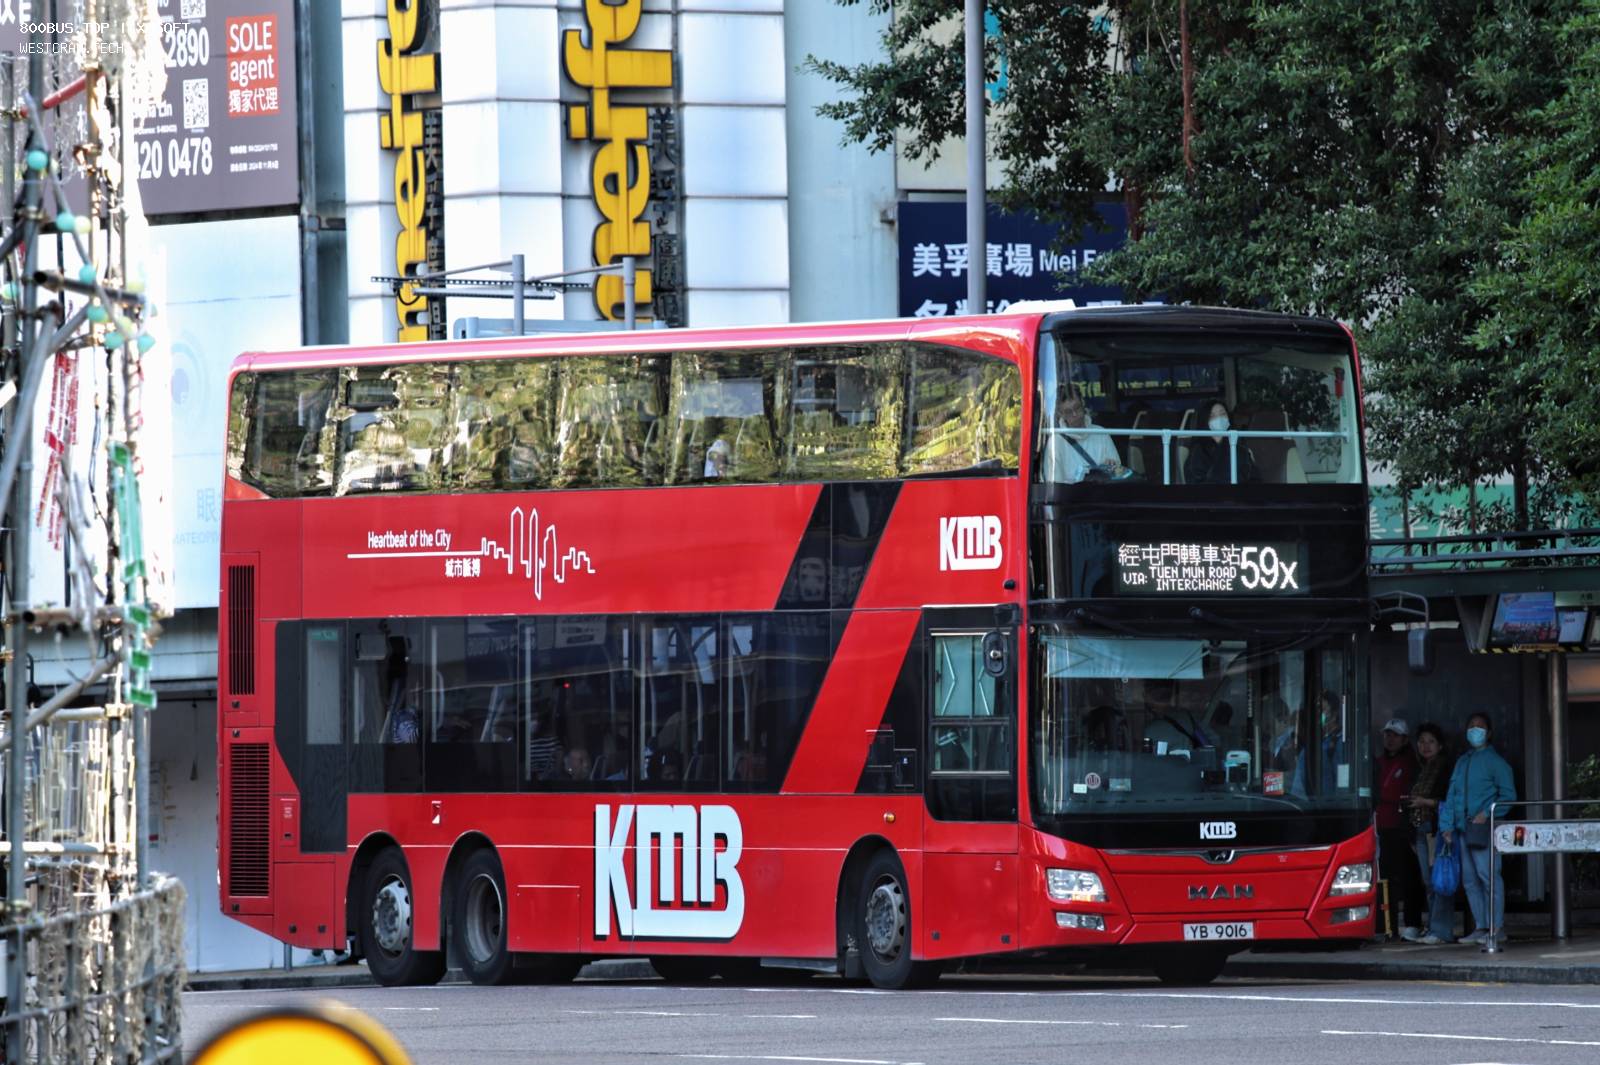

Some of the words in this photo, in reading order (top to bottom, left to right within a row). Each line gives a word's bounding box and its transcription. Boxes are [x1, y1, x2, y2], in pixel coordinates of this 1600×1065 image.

[165, 27, 210, 68] 2890
[229, 21, 273, 53] SOLE
[230, 54, 275, 86] agent
[228, 87, 279, 113] 獨家代理
[167, 136, 213, 178] 0478
[1039, 249, 1077, 271] Mei
[367, 530, 408, 549] Heartbeat
[409, 529, 419, 548] of
[419, 529, 434, 547] the
[435, 528, 452, 551] City
[939, 515, 1003, 572] KMB
[1118, 543, 1242, 567] 經屯門轉車站
[1123, 571, 1148, 585] VIA:
[1149, 566, 1179, 579] TUEN
[1182, 566, 1206, 579] MUN
[1208, 566, 1237, 579] ROAD
[1156, 578, 1234, 591] INTERCHANGE
[1199, 821, 1237, 840] KMB
[592, 803, 746, 942] KMB
[1187, 884, 1255, 900] MAN
[1190, 925, 1209, 939] YB
[1215, 924, 1248, 938] 9016
